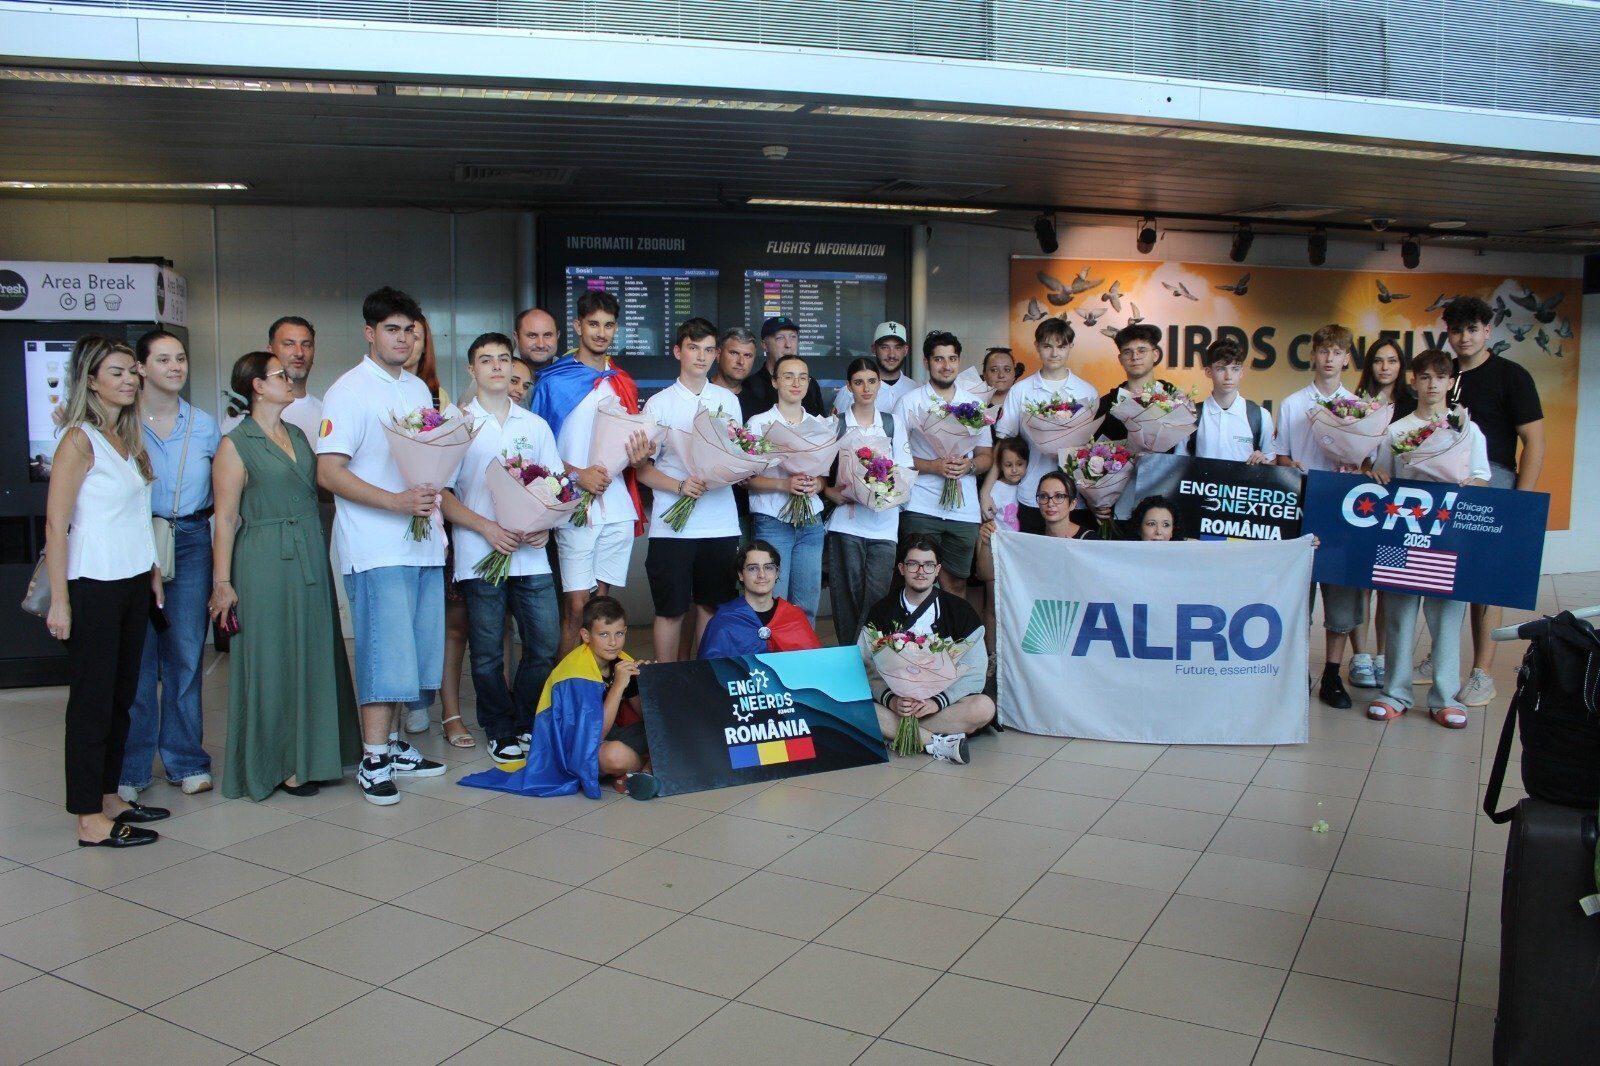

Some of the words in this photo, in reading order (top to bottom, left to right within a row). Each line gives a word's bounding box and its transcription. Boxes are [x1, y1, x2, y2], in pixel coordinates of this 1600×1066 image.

[566, 236, 633, 250] INFORMATII
[637, 238, 686, 251] ZBORURI
[766, 241, 811, 254] FLIGHTS
[814, 243, 887, 256] INFORMATION
[41, 273, 82, 290] Area
[88, 274, 136, 290] Break
[1288, 333, 1366, 370] CN
[1179, 480, 1298, 506] ENGINEERDS
[1341, 482, 1459, 536] CRI
[1456, 501, 1494, 515] Chicago
[1454, 511, 1495, 524] Robotics
[1200, 518, 1282, 541] ROMÂNIA
[1452, 520, 1503, 535] Invitational
[1403, 533, 1432, 549] 2025
[1070, 602, 1283, 661] ALRO
[1175, 664, 1217, 676] Future,
[1219, 664, 1280, 677] essentially
[739, 692, 794, 712] NEERDS
[724, 718, 812, 745] ROMÂNIA
